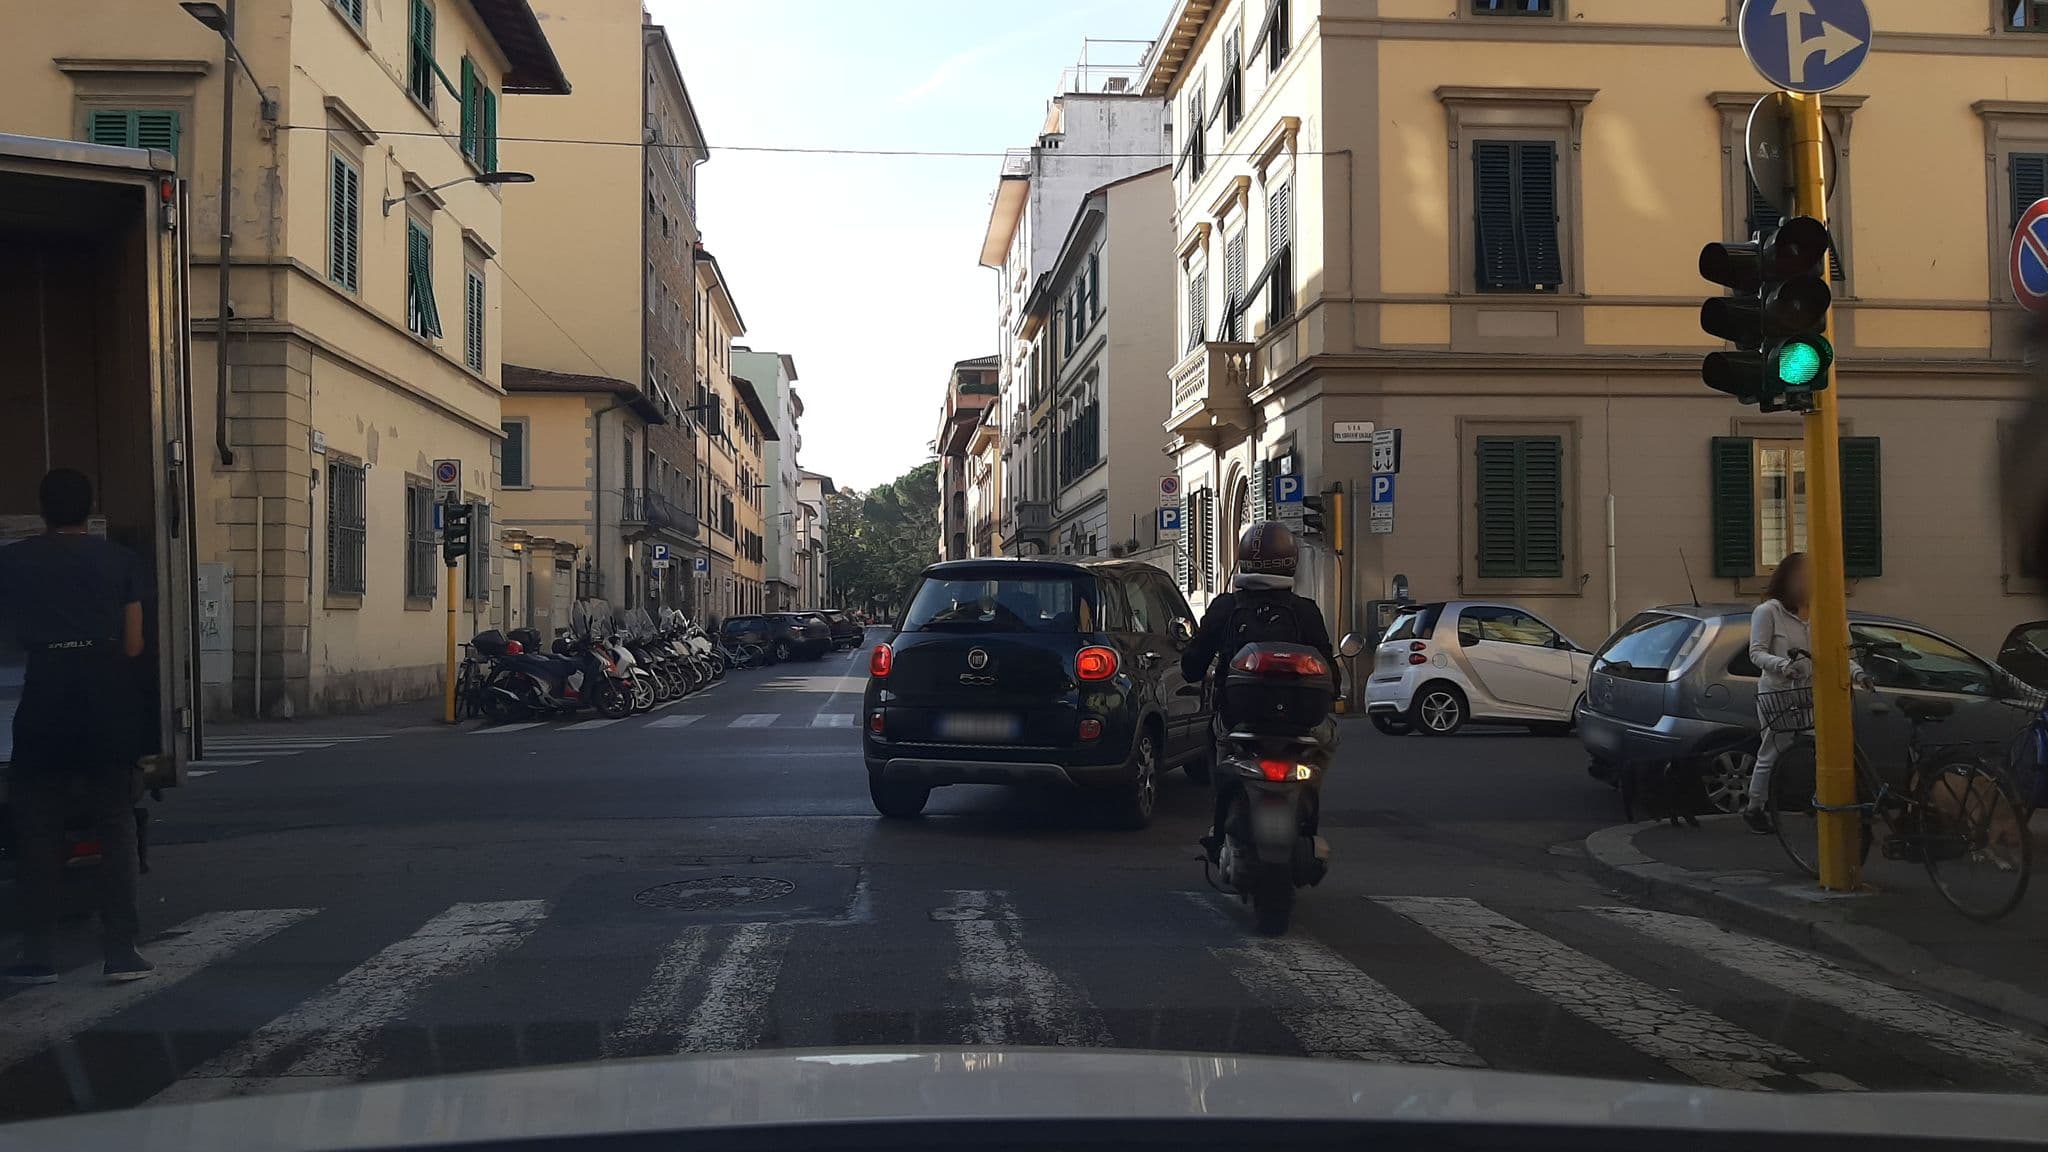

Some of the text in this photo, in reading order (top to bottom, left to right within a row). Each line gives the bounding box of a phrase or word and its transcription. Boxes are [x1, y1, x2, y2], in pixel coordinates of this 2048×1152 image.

[1280, 477, 1298, 501] P
[1375, 477, 1389, 501] P
[1163, 510, 1177, 528] P
[655, 546, 666, 559] P
[695, 558, 705, 570] P
